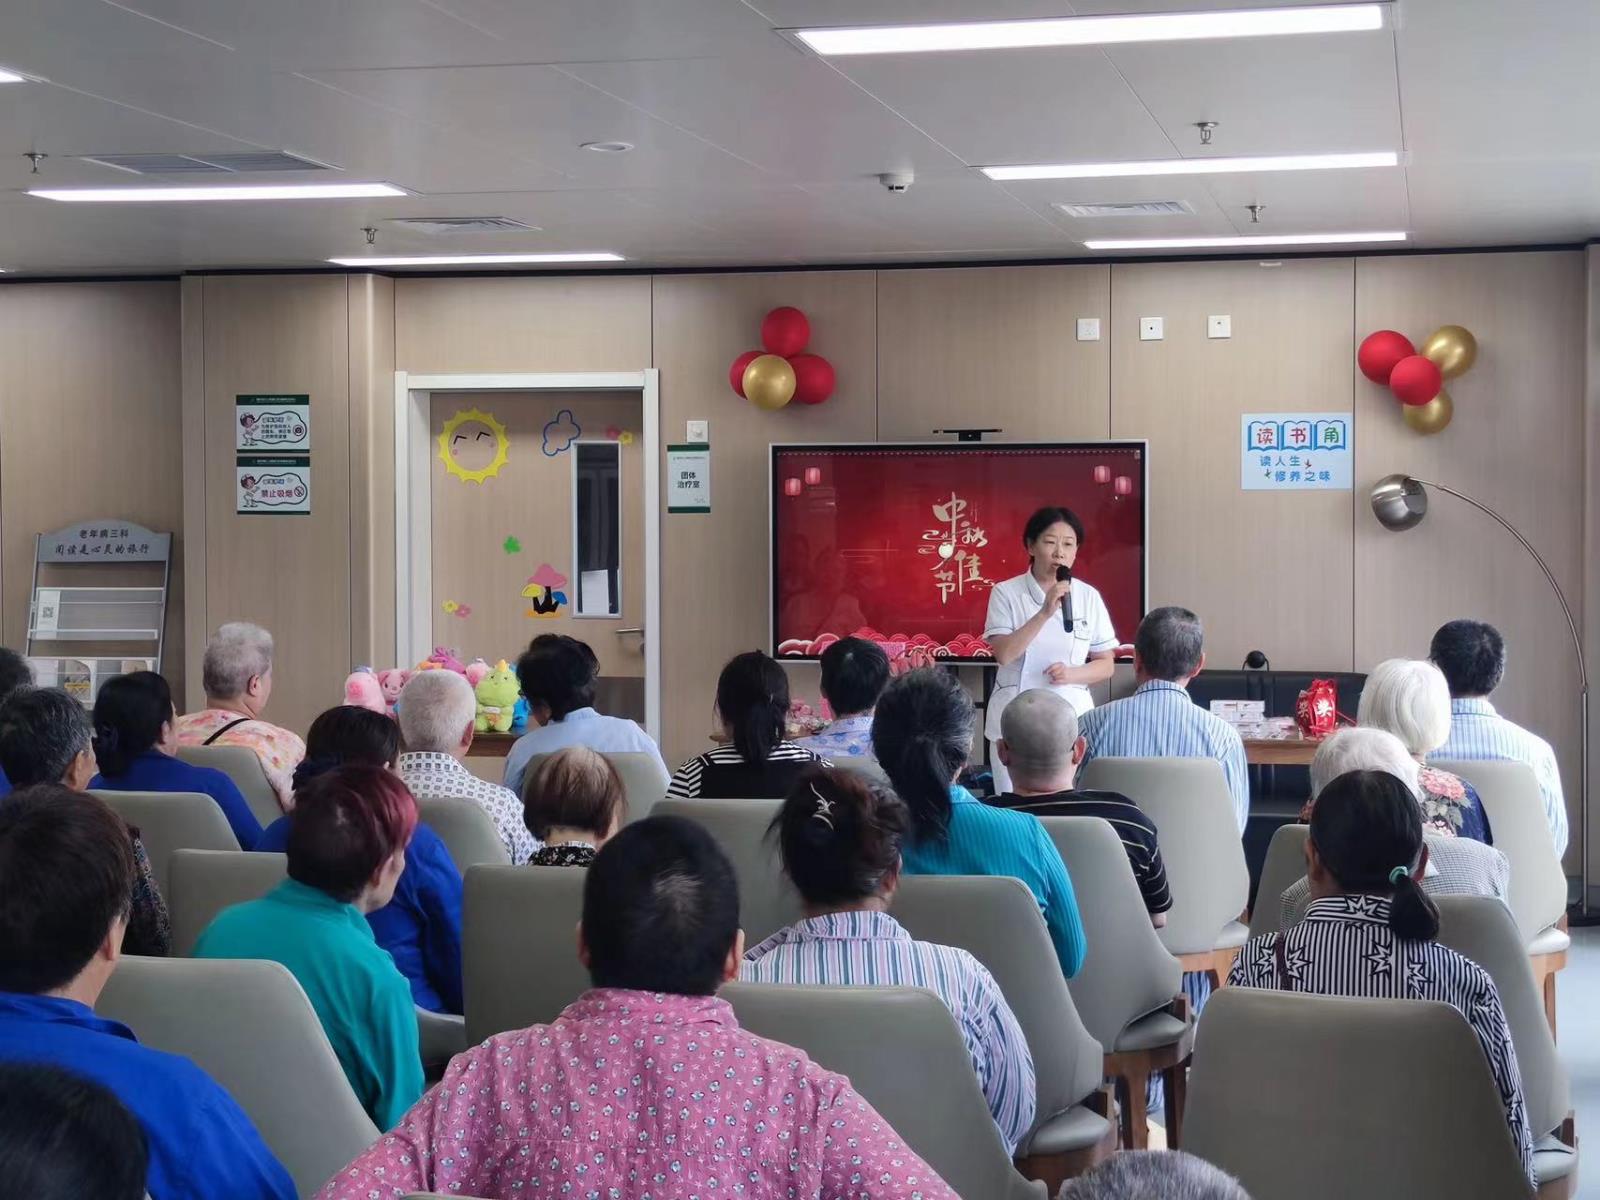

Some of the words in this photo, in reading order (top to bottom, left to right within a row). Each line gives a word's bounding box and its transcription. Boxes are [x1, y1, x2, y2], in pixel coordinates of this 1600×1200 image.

[1257, 427, 1339, 444] 读书角
[1260, 456, 1300, 467] 读人生
[680, 471, 696, 479] 团体
[1275, 471, 1330, 482] 修养之味
[262, 490, 293, 498] 禁止吸烟
[80, 529, 129, 539] 老年病三科
[55, 544, 149, 556] 阅读是心灵的旅行
